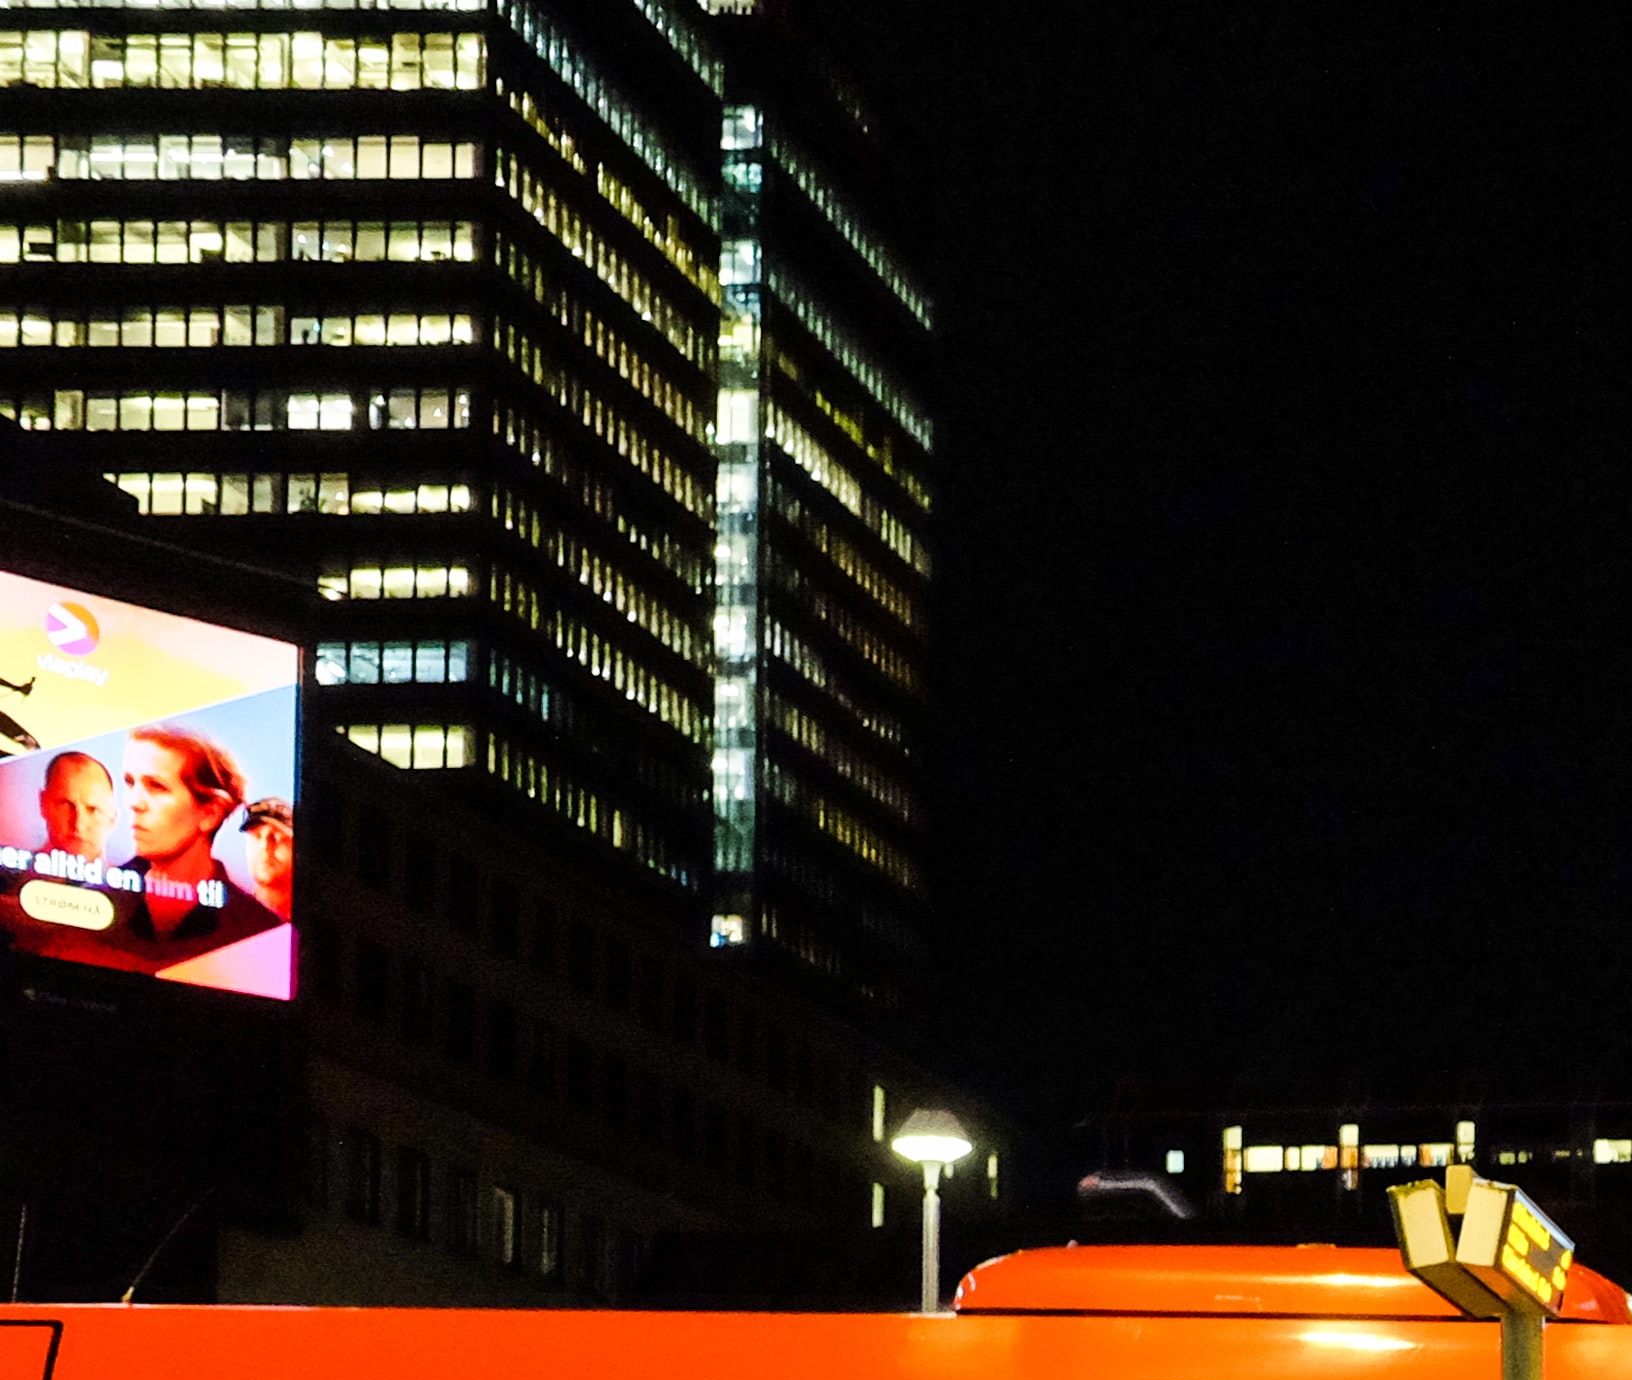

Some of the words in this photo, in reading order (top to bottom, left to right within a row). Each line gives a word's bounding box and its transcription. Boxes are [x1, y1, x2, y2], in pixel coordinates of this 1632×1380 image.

[0, 846, 31, 870] er
[34, 848, 102, 886] alltid
[106, 867, 141, 893] en
[145, 869, 193, 902] film
[198, 880, 227, 909] til
